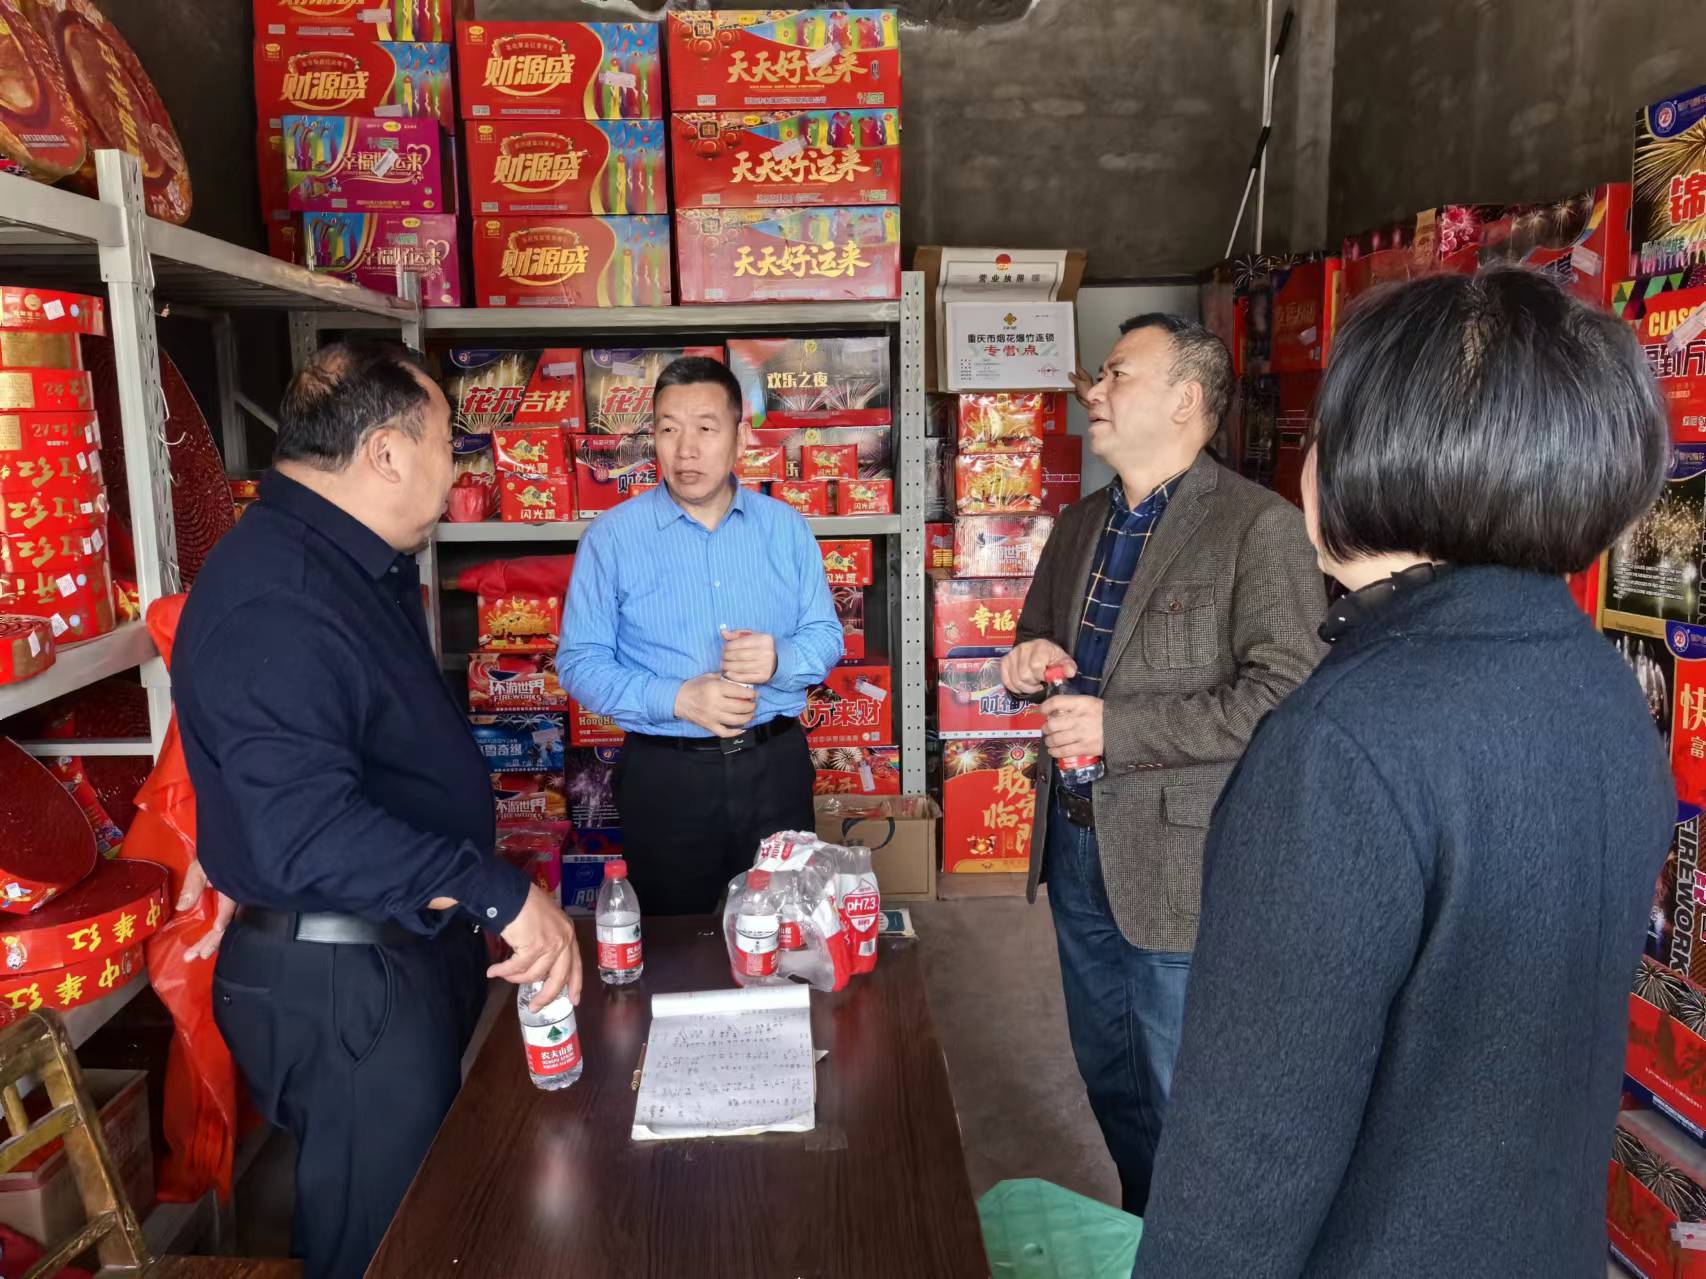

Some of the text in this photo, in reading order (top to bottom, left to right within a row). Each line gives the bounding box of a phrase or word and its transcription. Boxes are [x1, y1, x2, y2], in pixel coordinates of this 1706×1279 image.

[482, 54, 576, 87] 财源盛
[280, 71, 369, 101] 财源盛
[491, 151, 583, 183] 财源盛
[730, 145, 870, 184] 天天好运来
[499, 245, 590, 277] 财源盛
[734, 240, 870, 276] 天天好运来
[967, 333, 1055, 344] 重庆市烟花爆竹连锁
[984, 345, 1039, 357] 专营点
[767, 371, 828, 388] 欢乐之夜
[462, 385, 571, 415] 花开吉祥
[489, 680, 545, 696] 环游世界
